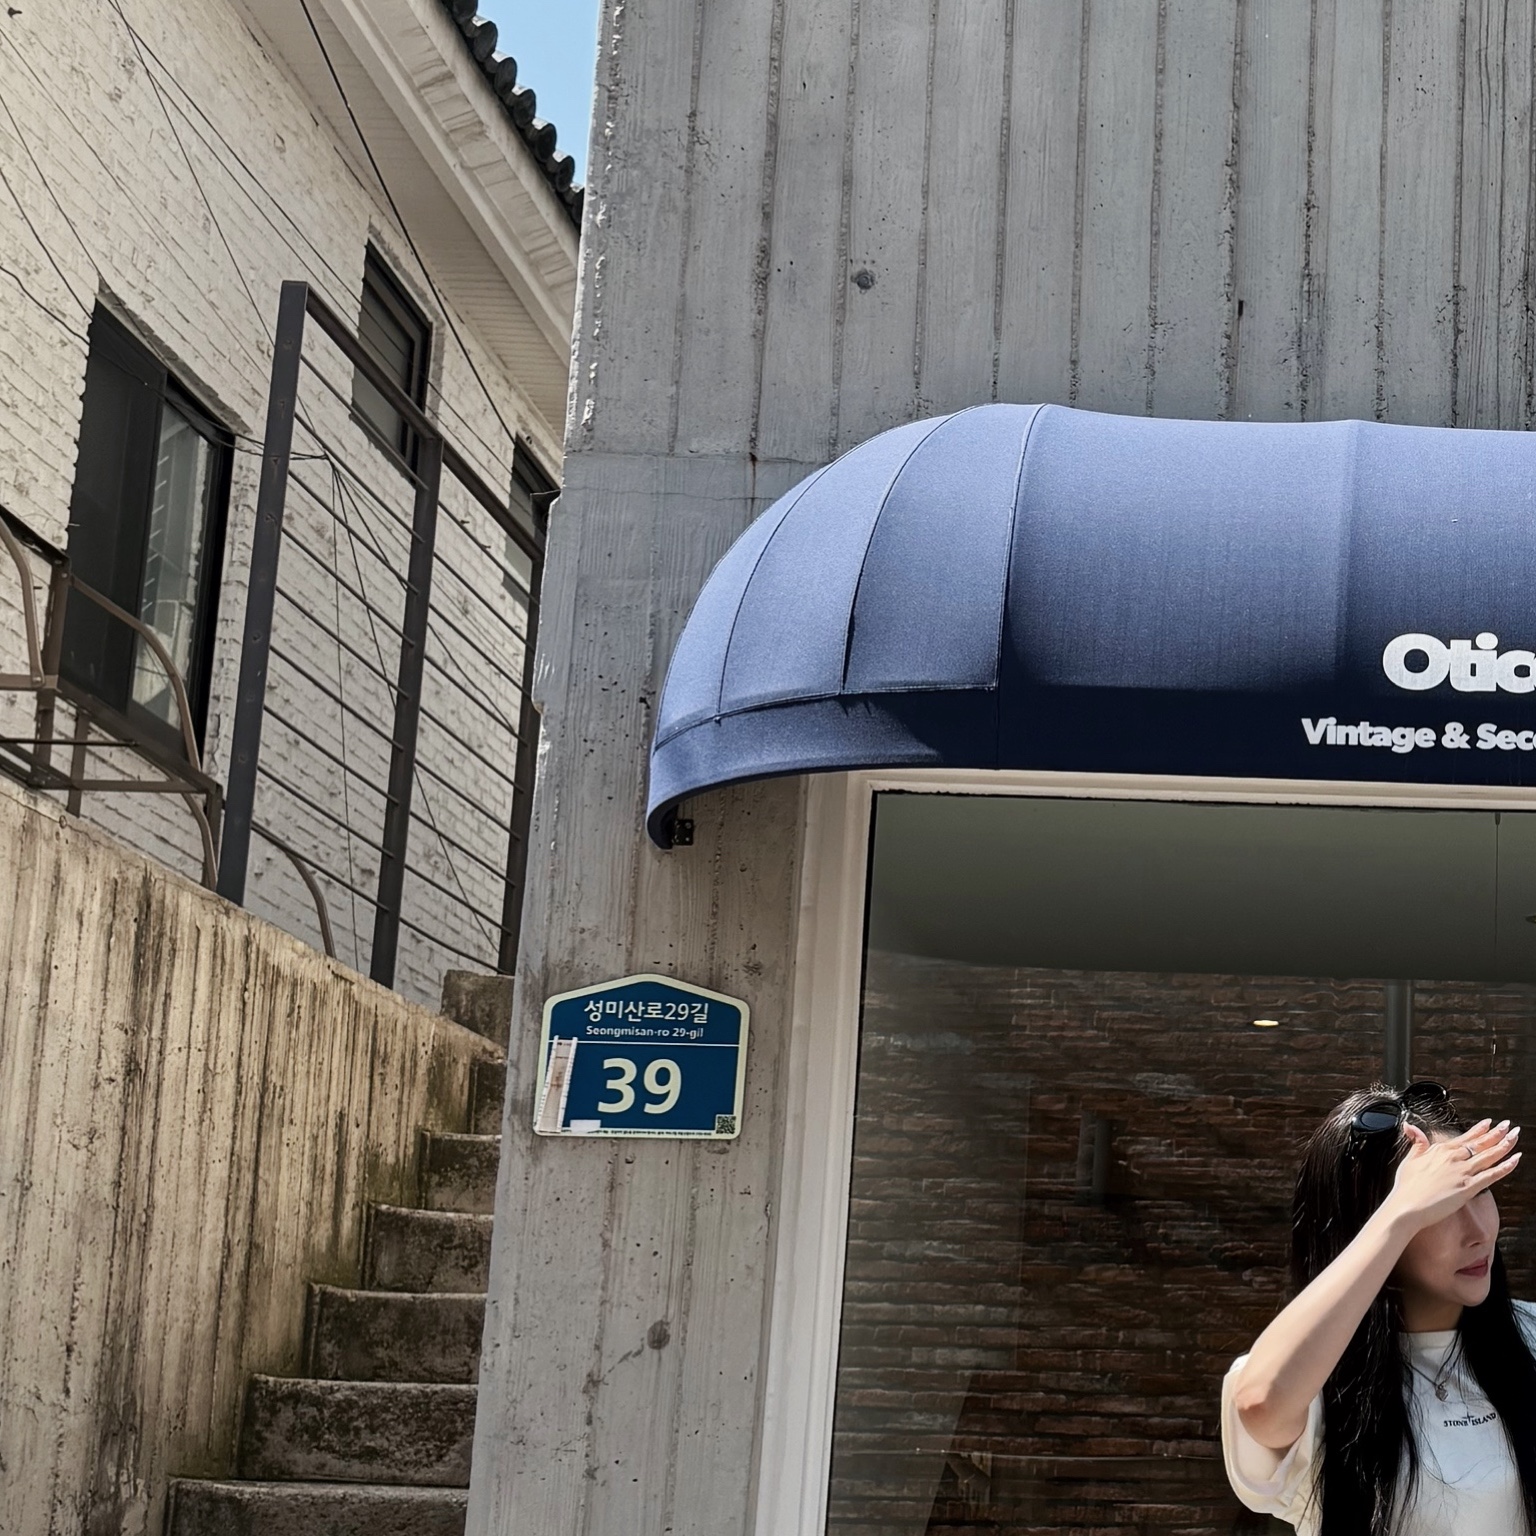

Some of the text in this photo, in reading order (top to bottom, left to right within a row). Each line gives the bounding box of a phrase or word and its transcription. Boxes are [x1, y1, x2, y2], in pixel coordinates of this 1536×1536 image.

[1301, 716, 1435, 754] Vintage
[1441, 721, 1471, 750] &
[584, 1000, 708, 1023] 성미산로29길
[586, 1025, 703, 1039] Seongmisan-ro 29-gil
[598, 1058, 682, 1114] 39
[1471, 1412, 1496, 1426] ISLAND
